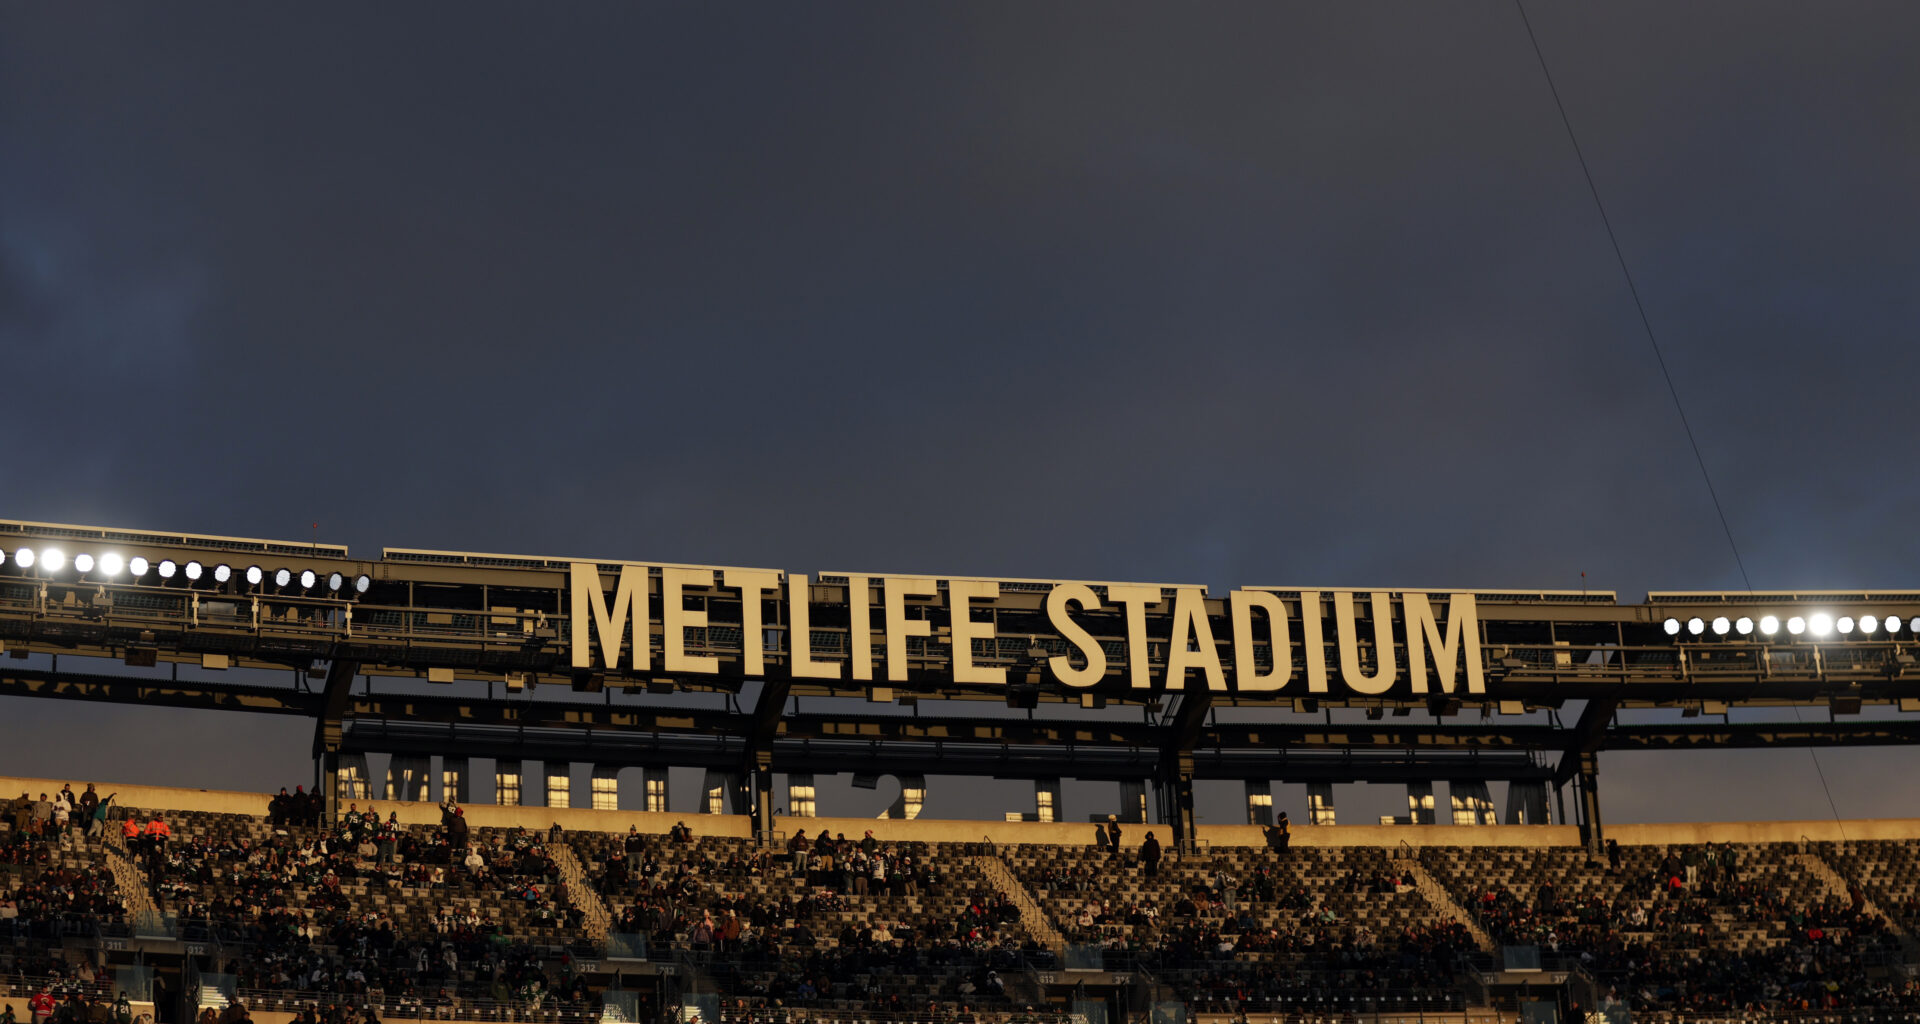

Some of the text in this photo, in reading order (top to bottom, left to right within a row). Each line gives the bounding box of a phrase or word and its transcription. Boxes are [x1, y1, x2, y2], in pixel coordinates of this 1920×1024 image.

[570, 562, 1486, 694] METLIFE STADIUM
[107, 941, 122, 951] 311
[580, 963, 596, 973] 312
